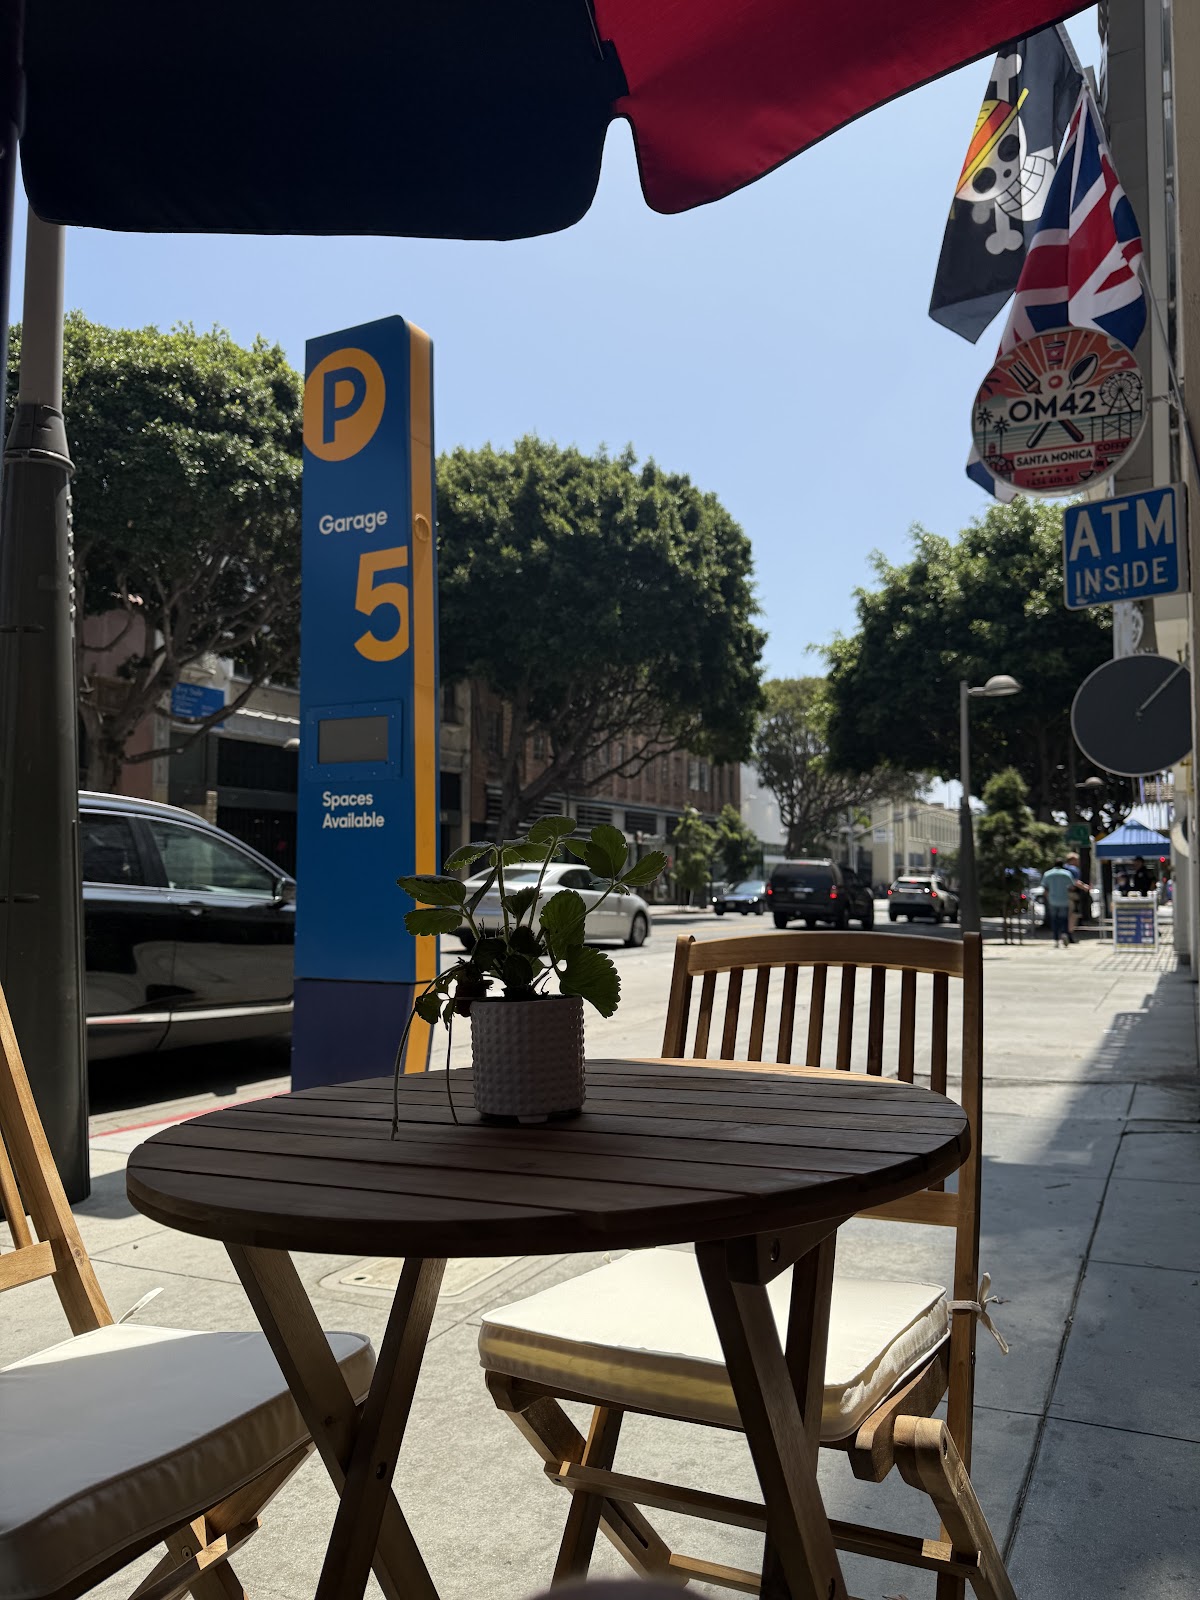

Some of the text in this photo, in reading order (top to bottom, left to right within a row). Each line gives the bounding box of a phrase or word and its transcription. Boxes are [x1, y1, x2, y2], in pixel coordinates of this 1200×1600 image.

[323, 366, 368, 445] P
[1008, 390, 1097, 424] OM42
[1016, 449, 1094, 467] SANTA MONICA
[318, 510, 389, 536] Garage
[1068, 491, 1175, 562] ATM
[1074, 555, 1169, 597] INSIDE
[353, 544, 410, 663] 5
[321, 790, 375, 812] Spaces
[321, 810, 386, 830] Available
